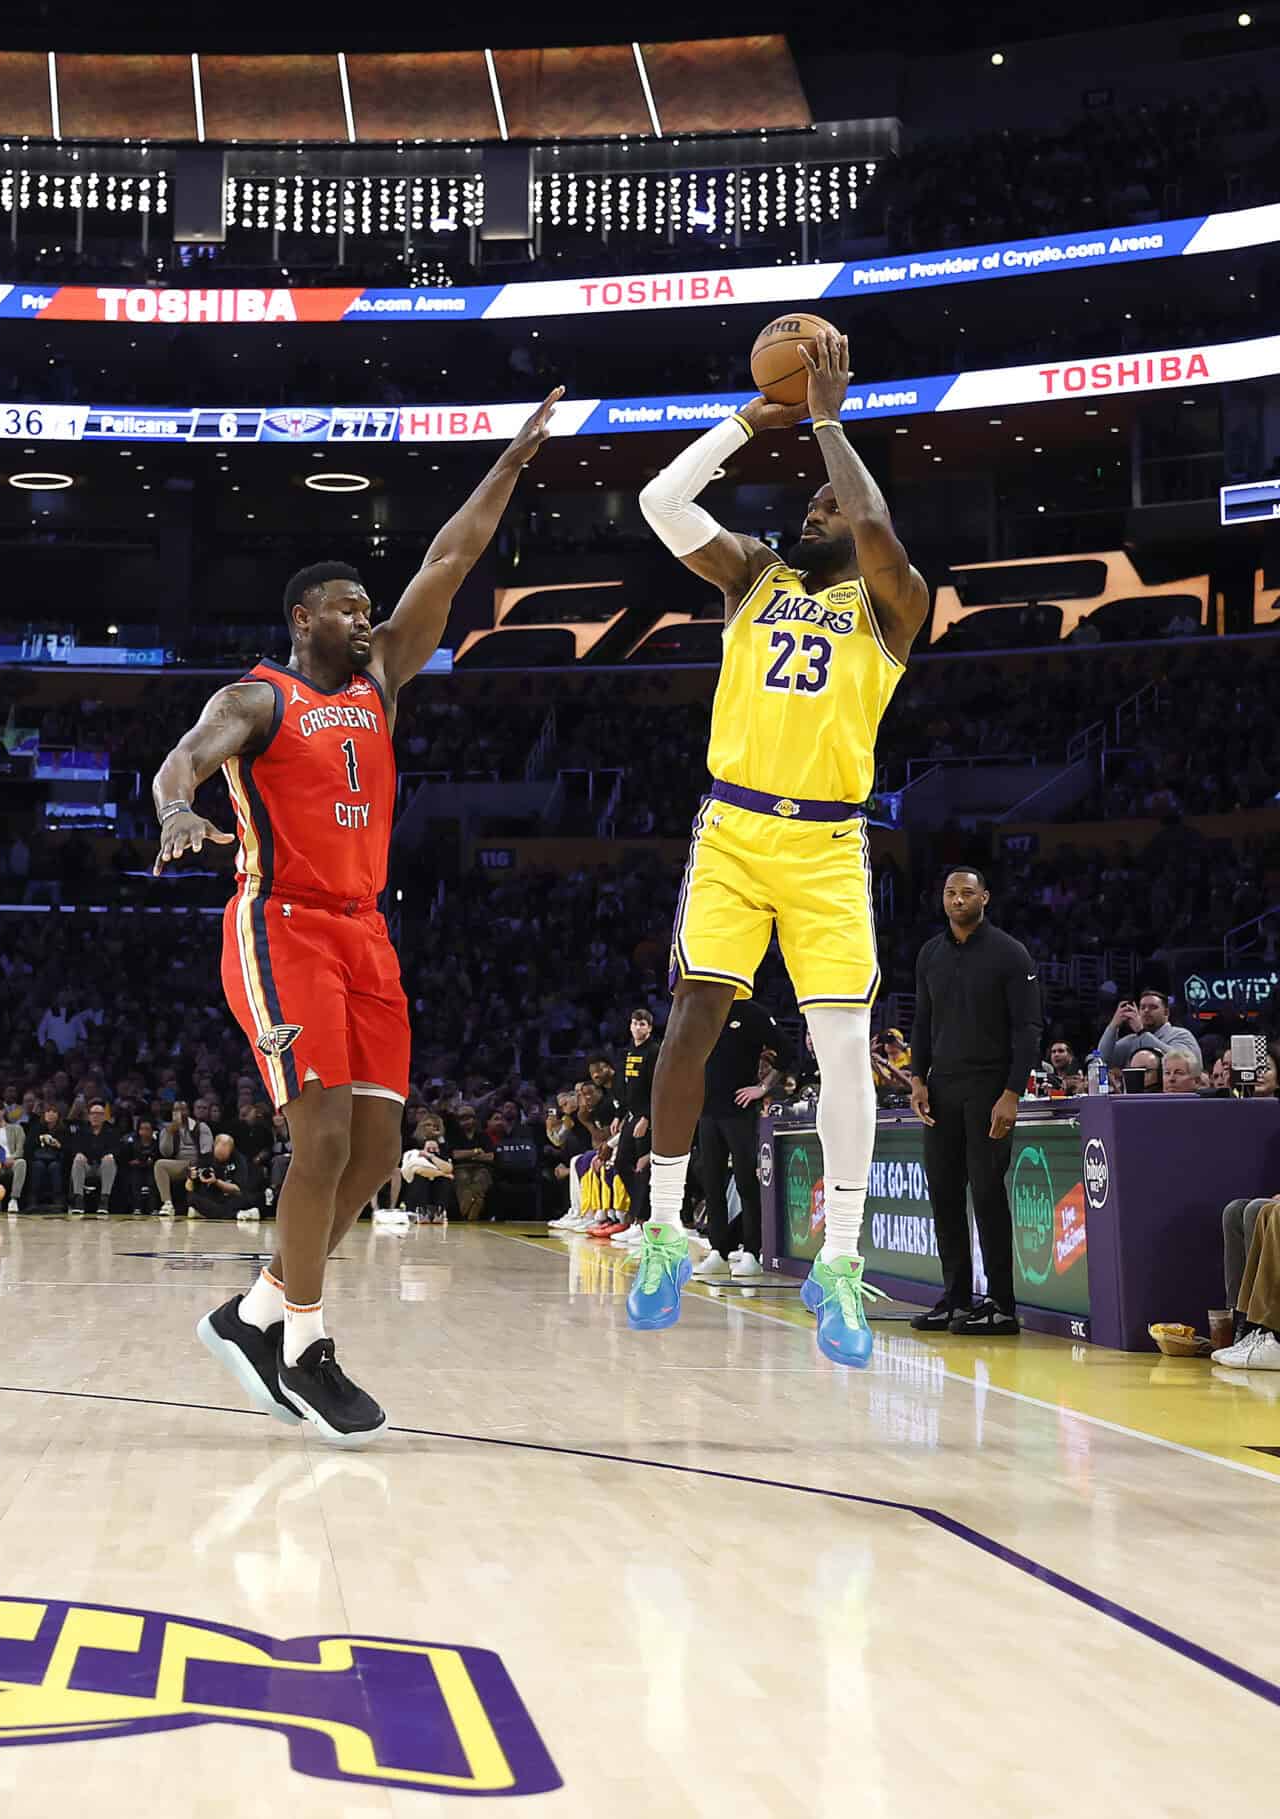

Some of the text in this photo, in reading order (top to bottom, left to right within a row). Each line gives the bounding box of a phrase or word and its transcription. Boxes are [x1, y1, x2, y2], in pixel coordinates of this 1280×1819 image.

[853, 233, 1164, 286] Printer Provider of Crypto.com Arena
[96, 287, 297, 322] TOSHIBA
[414, 295, 466, 311] Arena
[579, 275, 735, 308] TOSHIBA
[1039, 352, 1210, 396] TOSHIBA
[608, 407, 664, 424] Printer
[666, 402, 738, 421] Provider
[866, 390, 918, 409] Arena
[101, 415, 178, 434] Pelicans
[219, 413, 238, 437] 6
[753, 588, 855, 635] LAKERS
[764, 631, 834, 697] 23
[298, 706, 379, 737] CRESCENT
[340, 737, 361, 793] 1
[334, 801, 371, 829] CITY
[887, 1162, 923, 1201] GO-TO
[1085, 1157, 1107, 1188] bibigo
[1016, 1183, 1052, 1245] bibigo
[872, 1212, 886, 1249] OF
[887, 1213, 928, 1256] LAKERS
